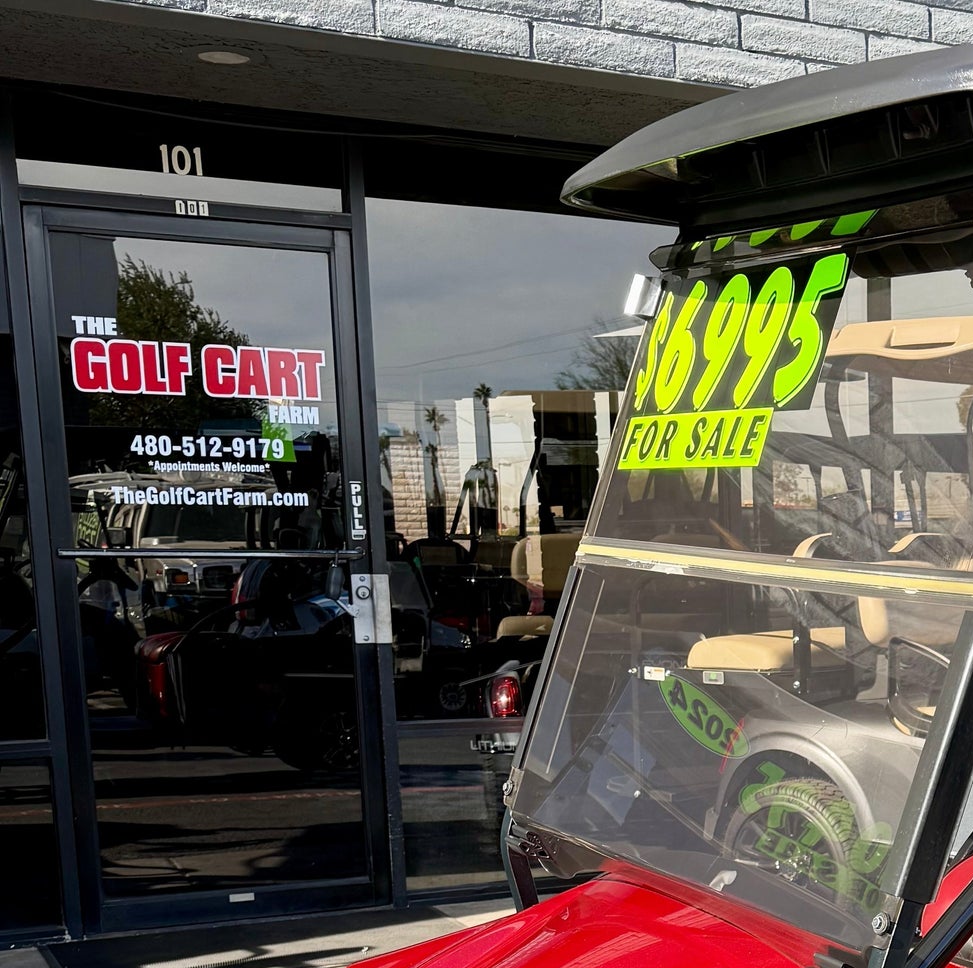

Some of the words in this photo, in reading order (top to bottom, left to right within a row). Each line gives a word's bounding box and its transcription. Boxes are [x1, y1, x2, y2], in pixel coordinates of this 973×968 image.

[160, 144, 203, 176] 101
[177, 202, 207, 215] 101
[71, 315, 118, 336] THE
[635, 253, 850, 414] $6995
[70, 336, 193, 396] GOLF
[200, 344, 326, 401] CART
[268, 405, 320, 425] FARM
[130, 434, 285, 459] 480-512-9179
[622, 420, 679, 463] FOR
[684, 414, 767, 460] SALE
[111, 485, 310, 507] TheGolfCartFarm.com
[350, 483, 364, 530] PULL
